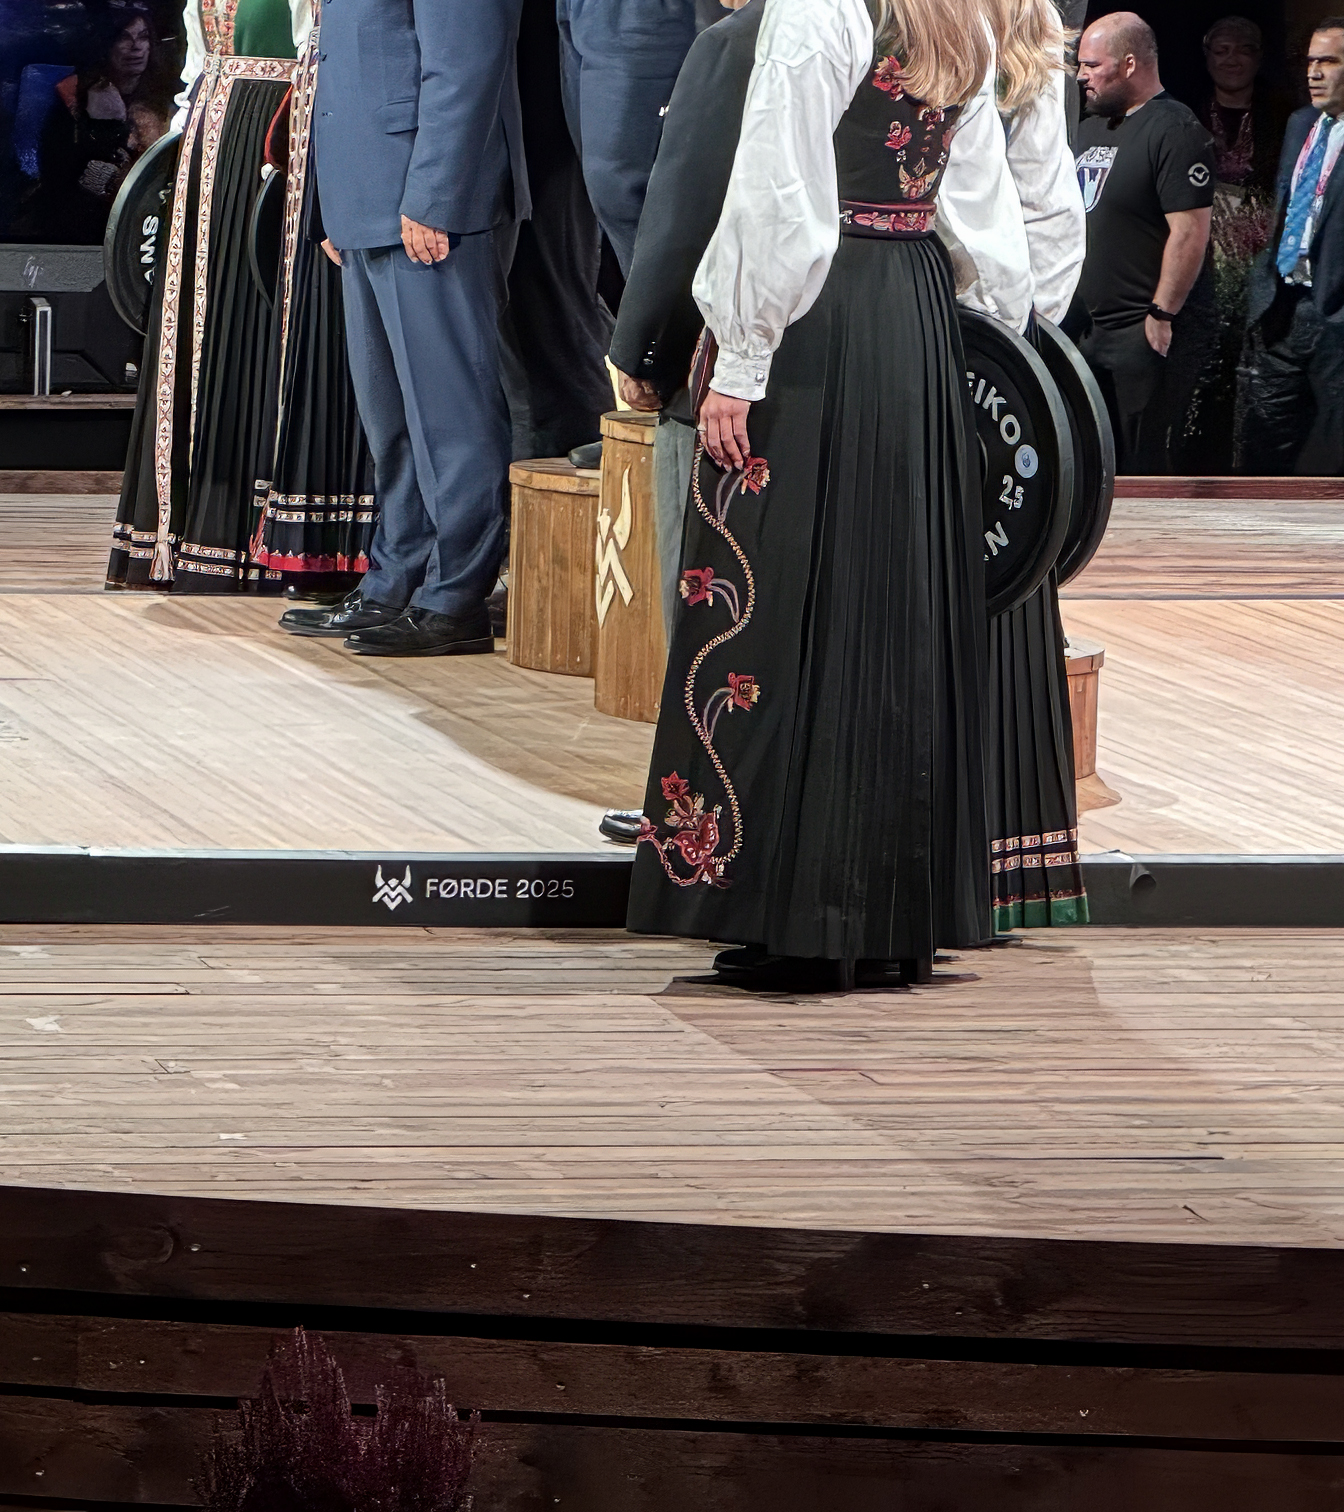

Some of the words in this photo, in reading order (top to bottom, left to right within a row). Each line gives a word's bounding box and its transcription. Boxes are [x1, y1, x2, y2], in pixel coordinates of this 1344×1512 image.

[999, 474, 1024, 510] 25
[426, 878, 508, 898] FØRDE
[516, 879, 575, 899] 2025
